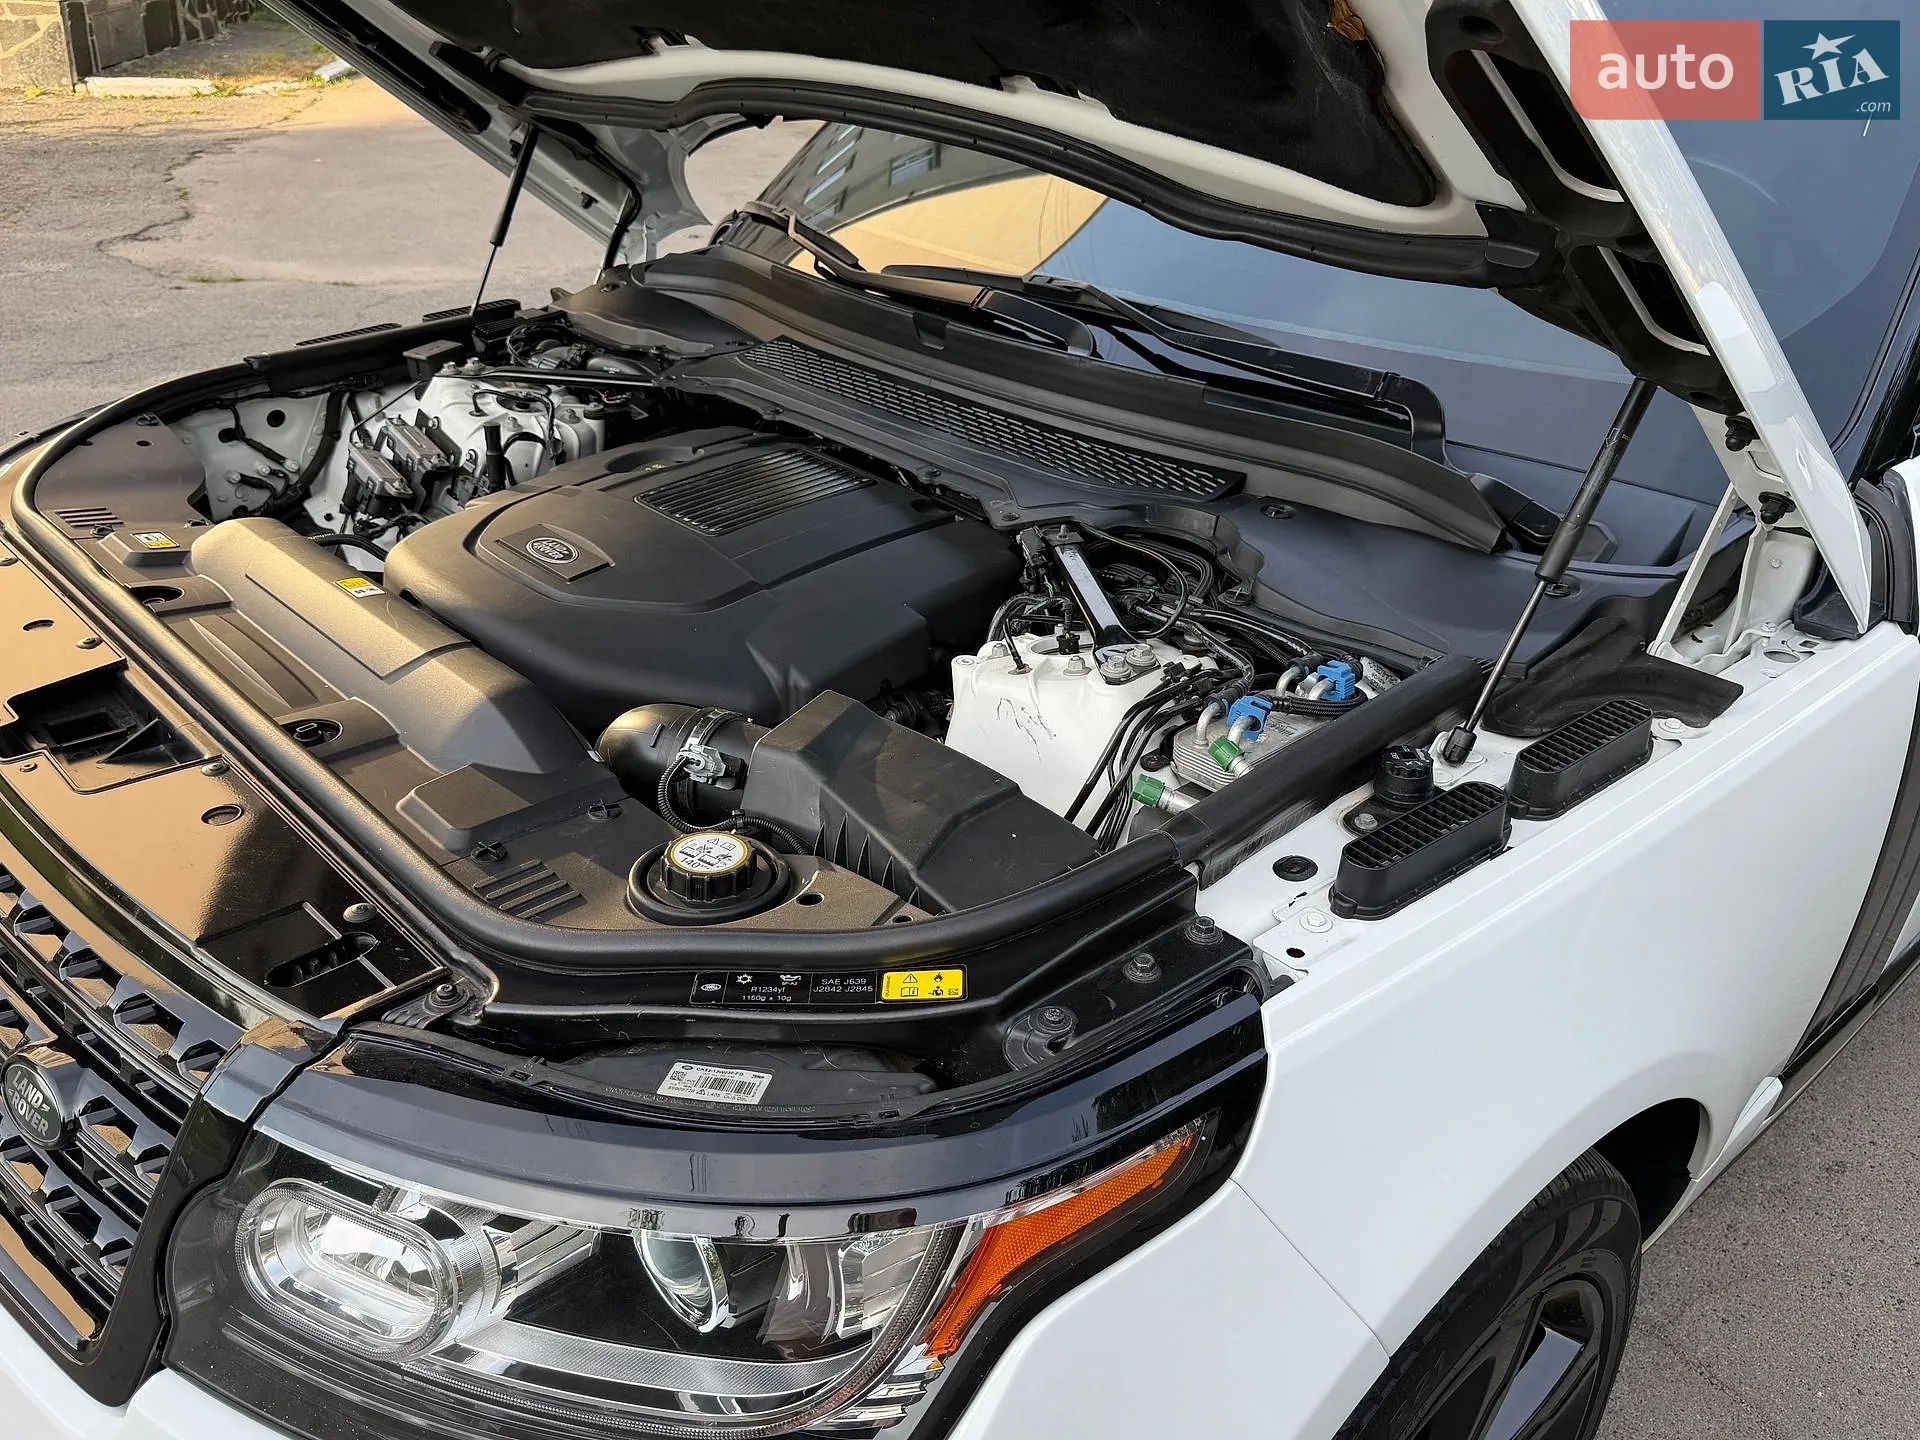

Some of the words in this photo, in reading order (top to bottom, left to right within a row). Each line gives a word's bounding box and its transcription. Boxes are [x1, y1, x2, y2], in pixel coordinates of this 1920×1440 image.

[533, 542, 564, 560] ROVER
[821, 978, 841, 986] SAE
[750, 986, 786, 994] R1234yf
[812, 985, 843, 993] J2842
[844, 985, 874, 993] J2845
[12, 1070, 44, 1109] LAND
[12, 1091, 49, 1137] ROVER
